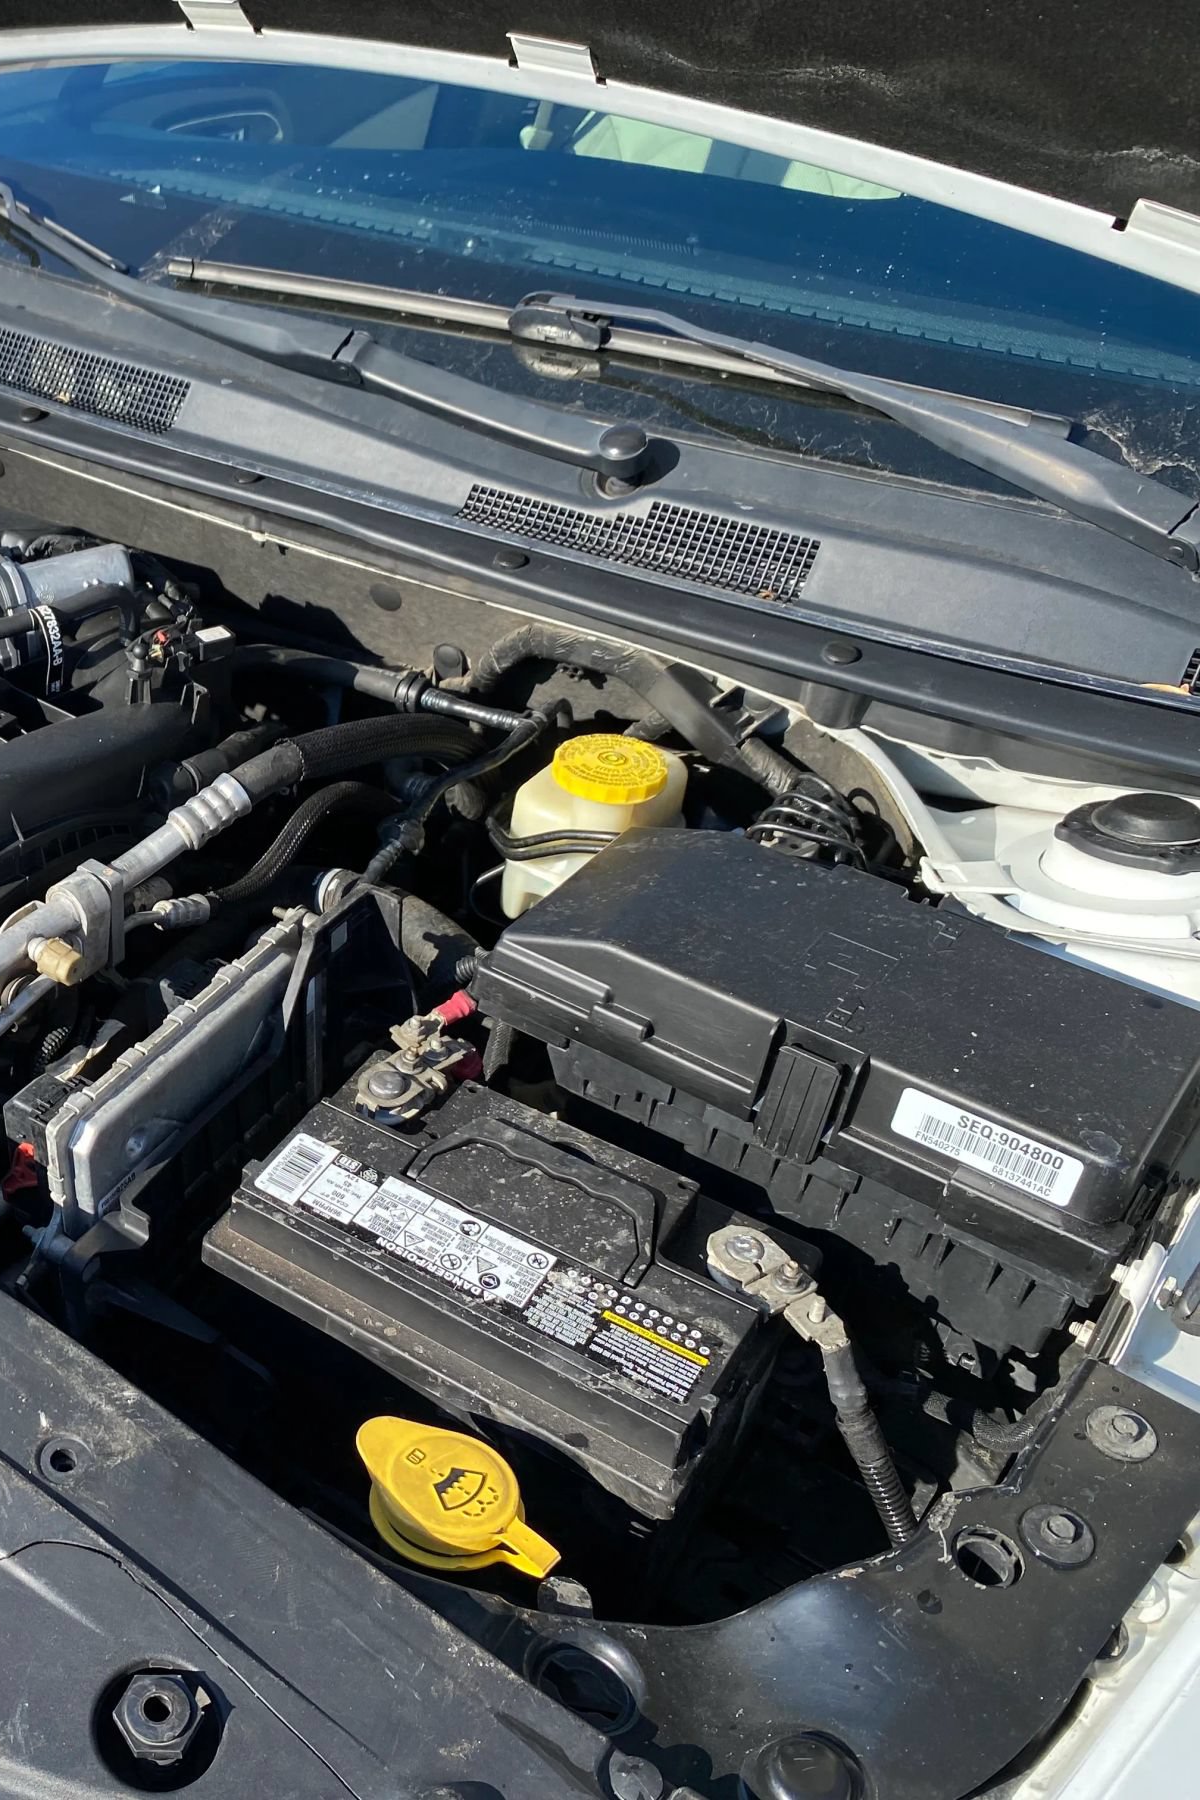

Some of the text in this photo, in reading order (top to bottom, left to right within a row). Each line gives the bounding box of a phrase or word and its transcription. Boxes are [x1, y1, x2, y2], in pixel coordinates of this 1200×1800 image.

[915, 1131, 960, 1157] FN540275
[957, 1115, 1064, 1170] SEQ:904800
[991, 1164, 1052, 1197] 68137441AC
[311, 1199, 342, 1216] 96RPRM
[375, 1237, 486, 1296] DANGER/POISON
